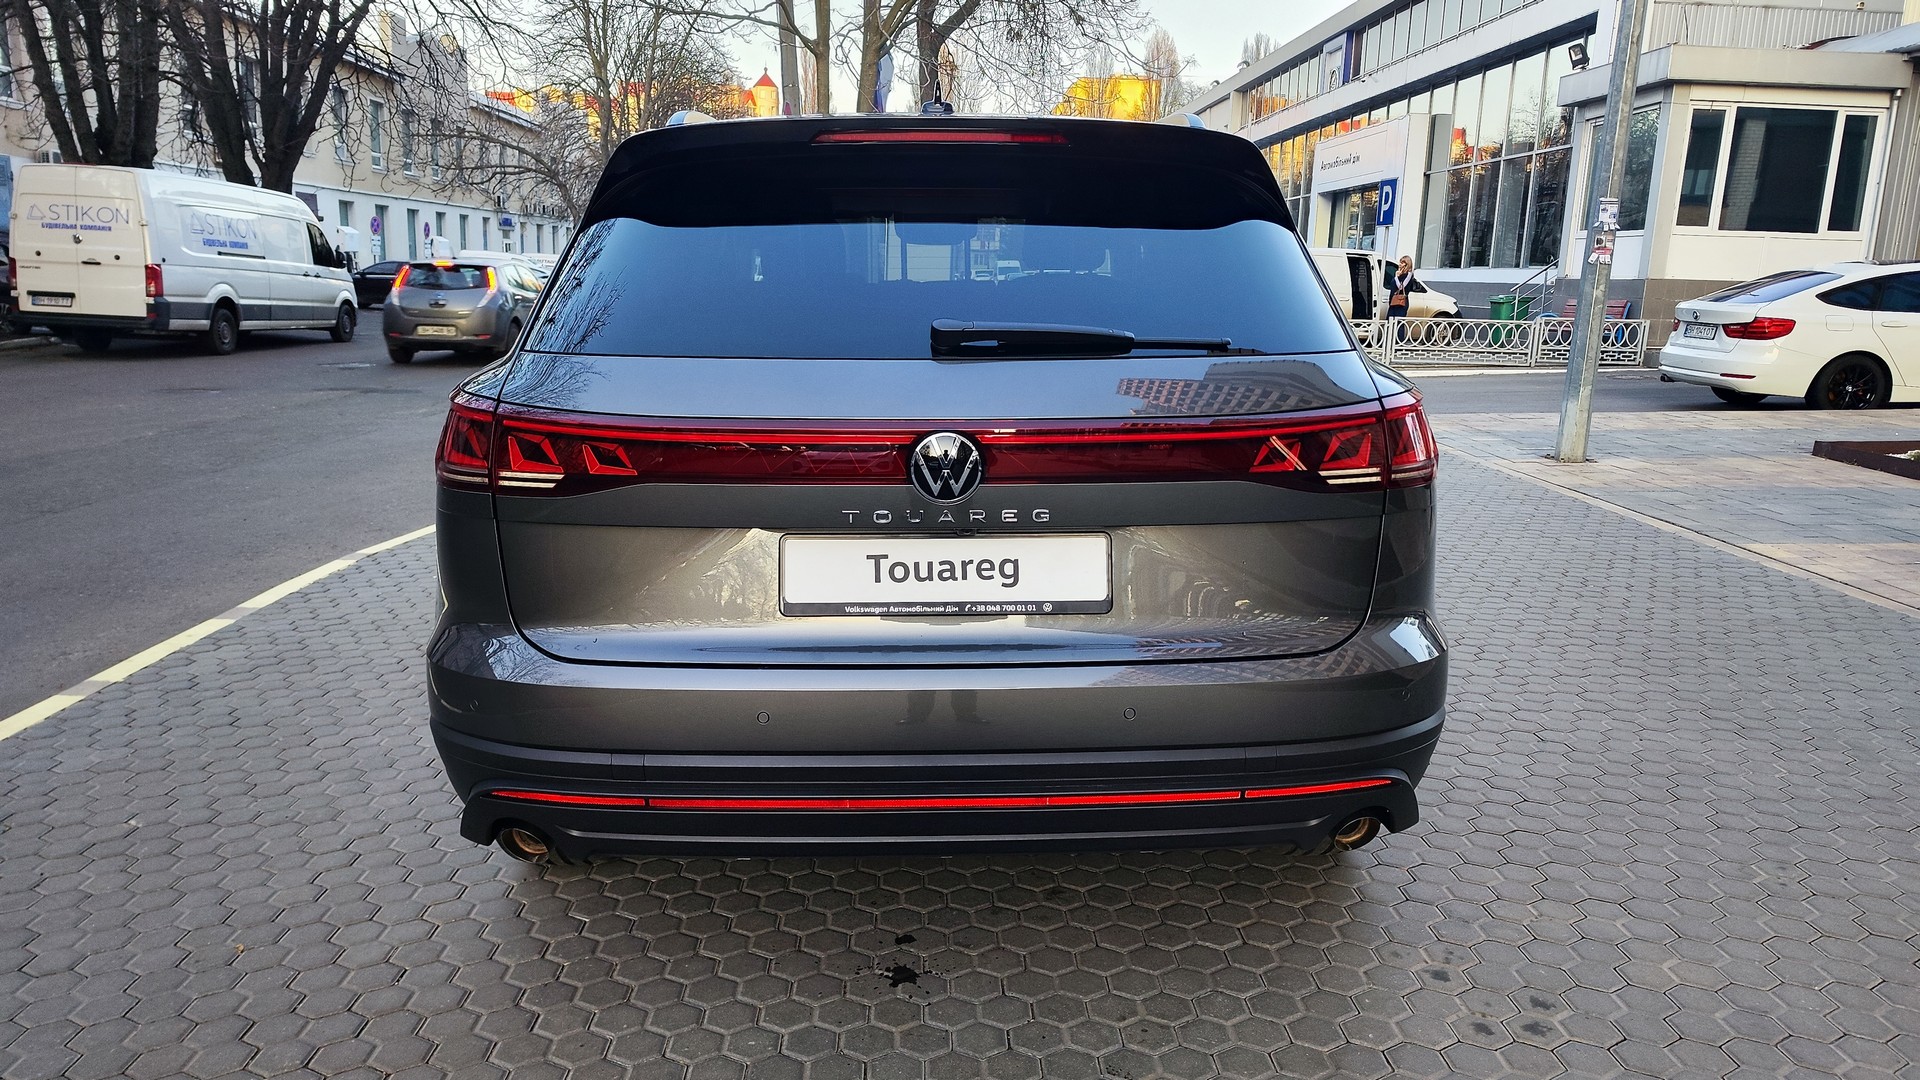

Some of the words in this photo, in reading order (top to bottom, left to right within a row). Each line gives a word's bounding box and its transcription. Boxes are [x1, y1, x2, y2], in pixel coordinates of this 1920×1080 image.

[1379, 185, 1392, 222] P
[841, 508, 1051, 524] TOUAREG
[866, 554, 1019, 588] Touareg
[844, 605, 888, 614] Volkswagen
[889, 604, 945, 613] Автомобільний
[945, 605, 959, 614] Дім
[971, 604, 986, 612] +38
[986, 604, 1001, 612] 048
[1001, 604, 1016, 612] 700
[1016, 604, 1026, 612] 01
[1027, 604, 1037, 612] 01
